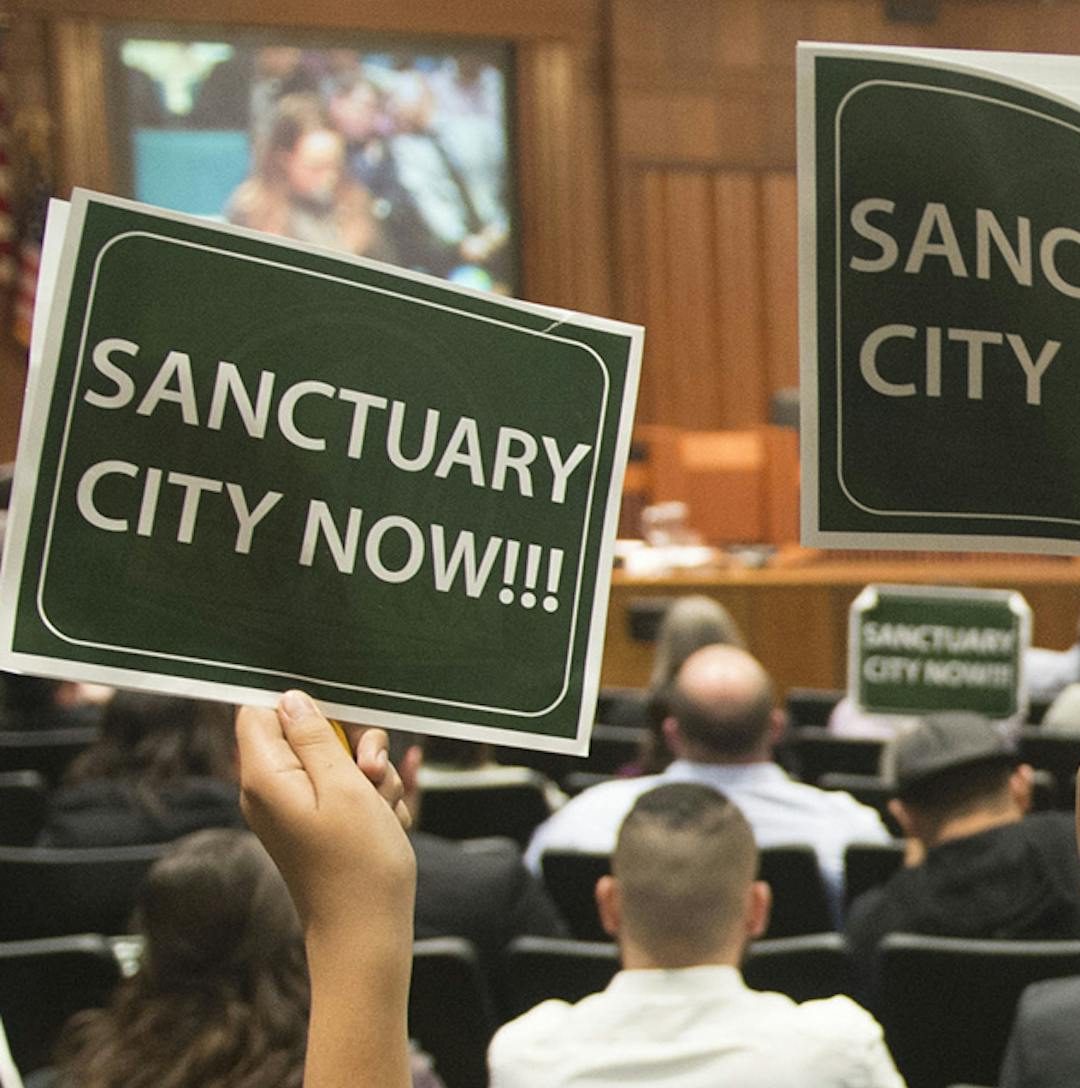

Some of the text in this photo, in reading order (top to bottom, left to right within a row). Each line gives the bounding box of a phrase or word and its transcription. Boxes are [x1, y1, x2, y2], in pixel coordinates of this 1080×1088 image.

[859, 324, 1061, 405] CITY
[83, 338, 592, 504] SANCTUARY
[76, 460, 565, 613] CITY NOW!!!
[863, 621, 1013, 655] SANCTUARY
[863, 655, 919, 684] CITY
